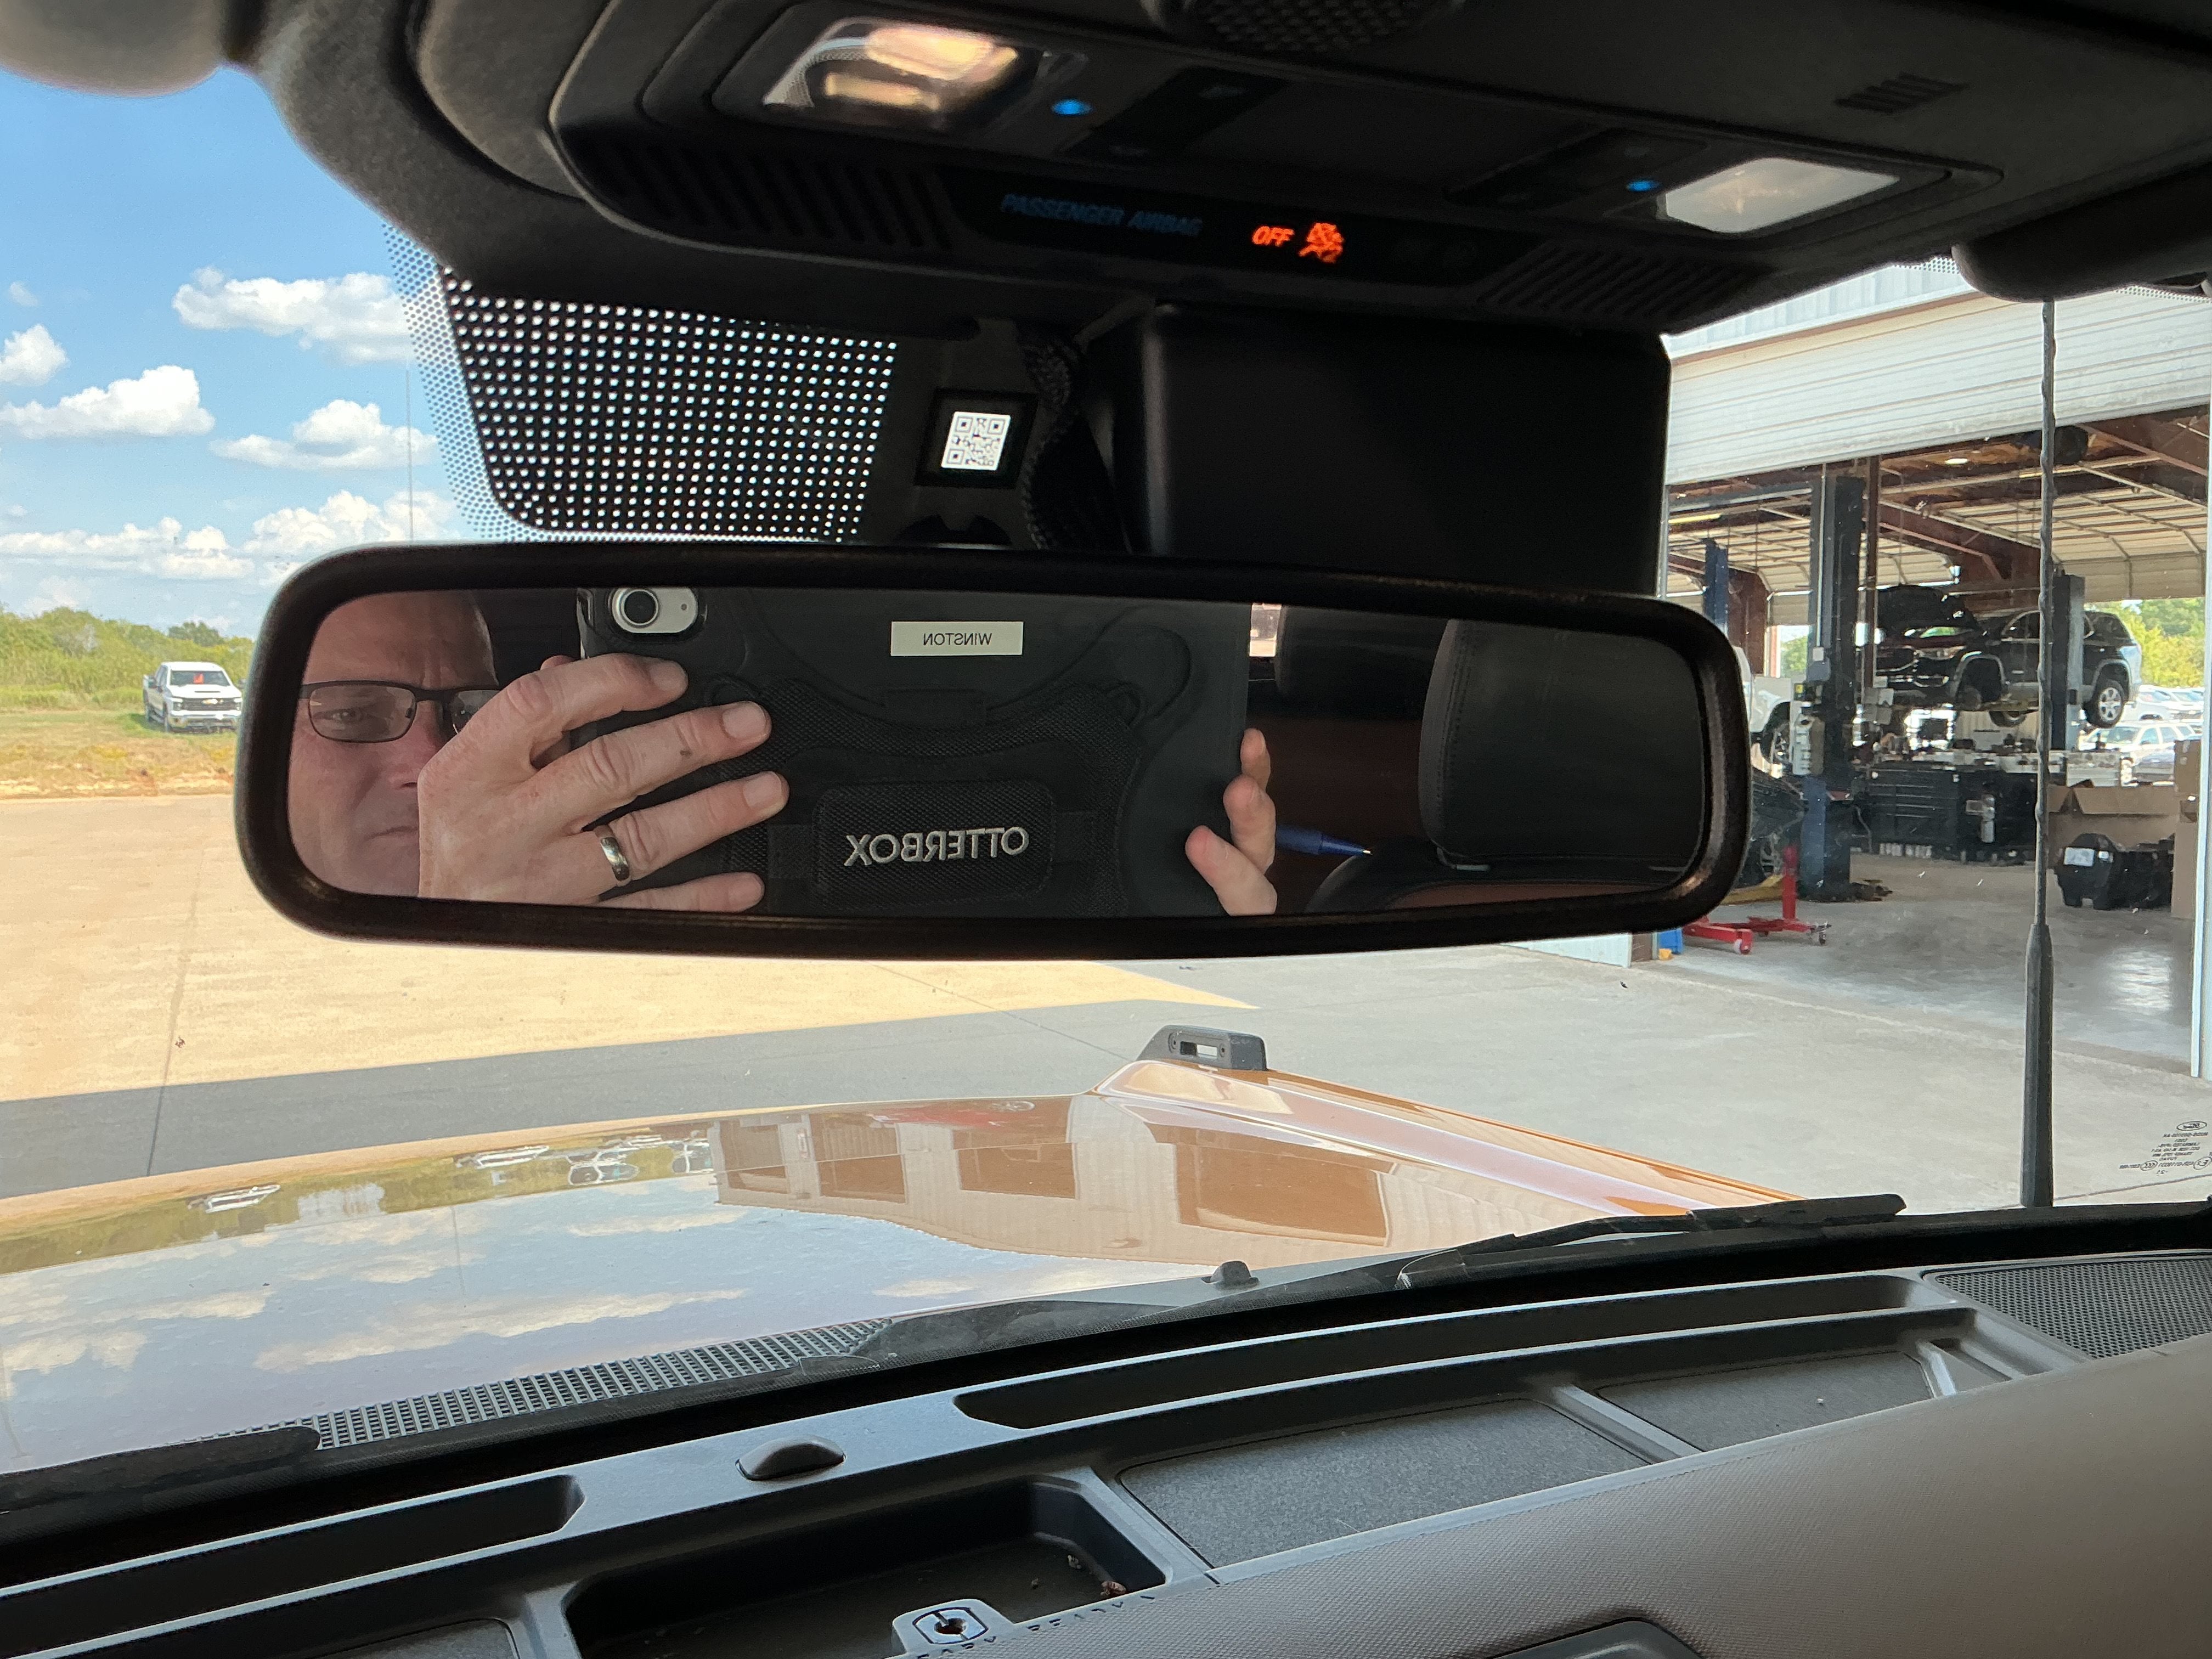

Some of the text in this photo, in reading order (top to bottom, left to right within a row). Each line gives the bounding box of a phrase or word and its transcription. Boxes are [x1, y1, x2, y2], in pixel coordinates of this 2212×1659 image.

[1000, 193, 1295, 248] PASSENGER AIRBAG OFF
